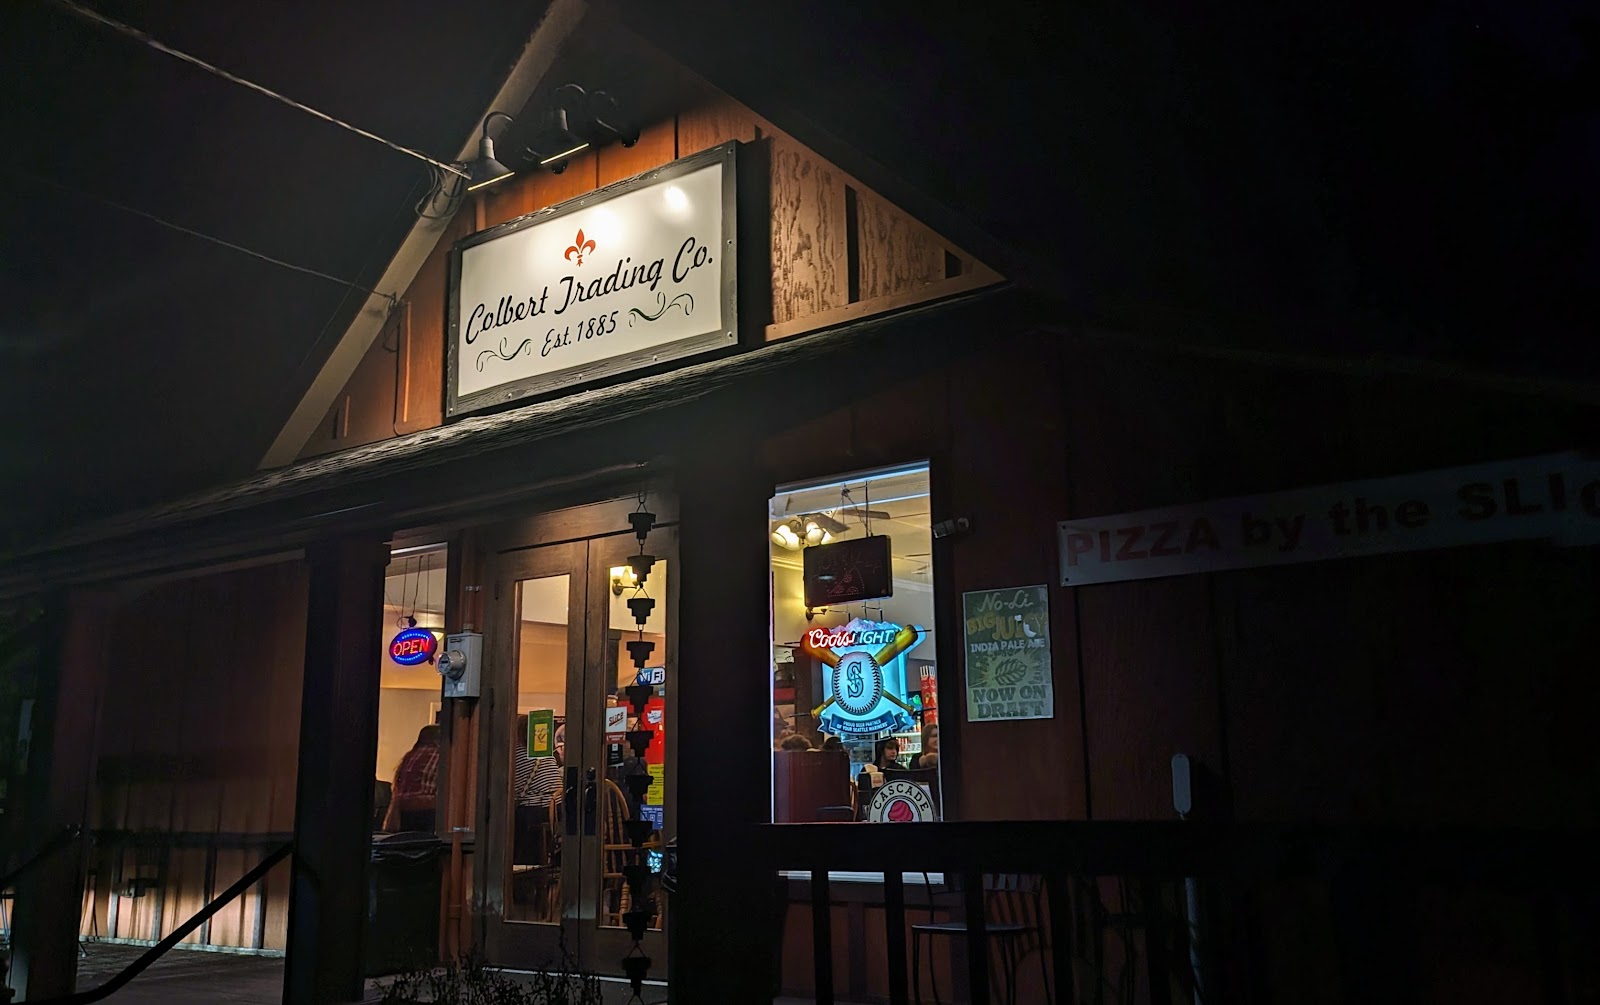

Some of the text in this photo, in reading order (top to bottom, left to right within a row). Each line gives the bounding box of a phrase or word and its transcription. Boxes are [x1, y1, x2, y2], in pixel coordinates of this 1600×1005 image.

[465, 236, 713, 345] Colbert Trading Co.
[576, 310, 619, 342] 1885
[1066, 516, 1221, 567] PIZZA
[1242, 511, 1306, 553] by
[1328, 497, 1430, 535] the
[977, 590, 1034, 612] No-Li
[393, 637, 430, 656] OPEN
[809, 629, 852, 648] Coors
[970, 642, 999, 653] INDIA
[1001, 639, 1025, 650] PALE
[973, 685, 1047, 703] NOW ON
[977, 701, 1045, 718] DRAFT
[873, 783, 929, 812] CASCADE
